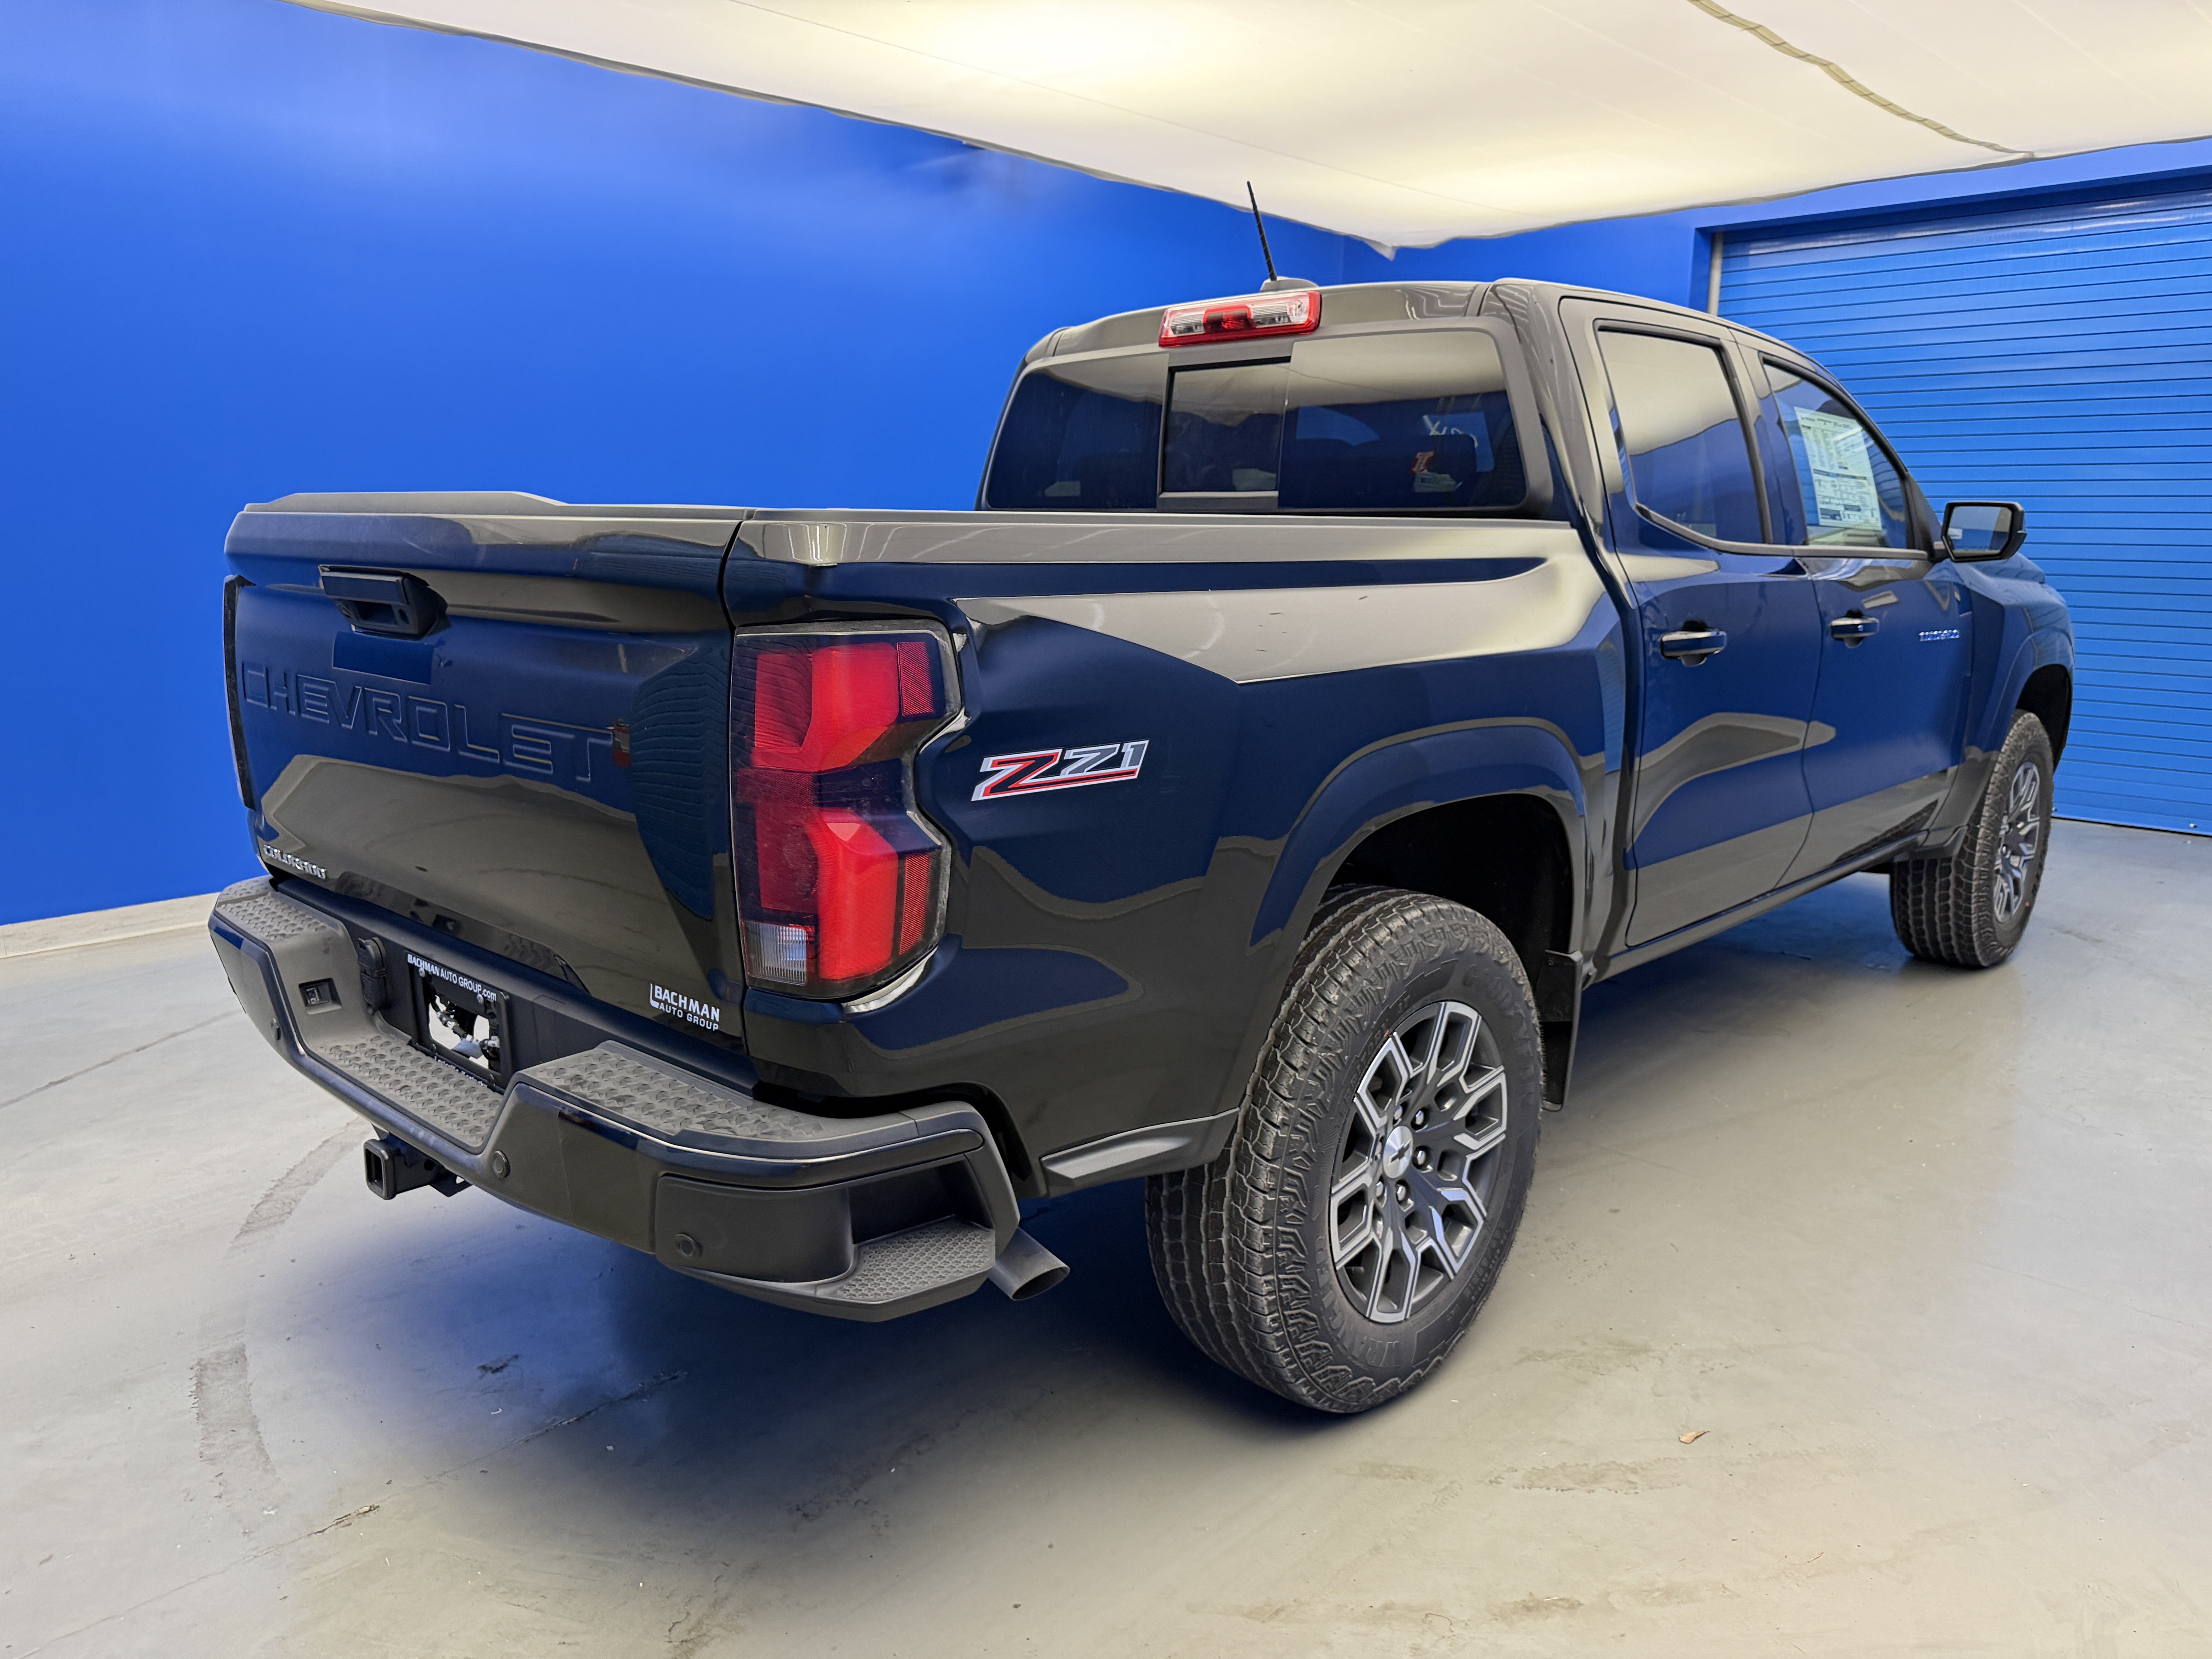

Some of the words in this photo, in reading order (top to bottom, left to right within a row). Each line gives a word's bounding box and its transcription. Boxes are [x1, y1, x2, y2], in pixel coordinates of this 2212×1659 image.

[242, 662, 613, 781] CHEVROLET
[971, 739, 1149, 801] Z71
[407, 954, 440, 977] BACHMAN
[440, 970, 457, 984] AUTO
[655, 985, 720, 1022] BACHMAN
[659, 1002, 683, 1018] AUTO
[687, 1013, 719, 1031] GROUP
